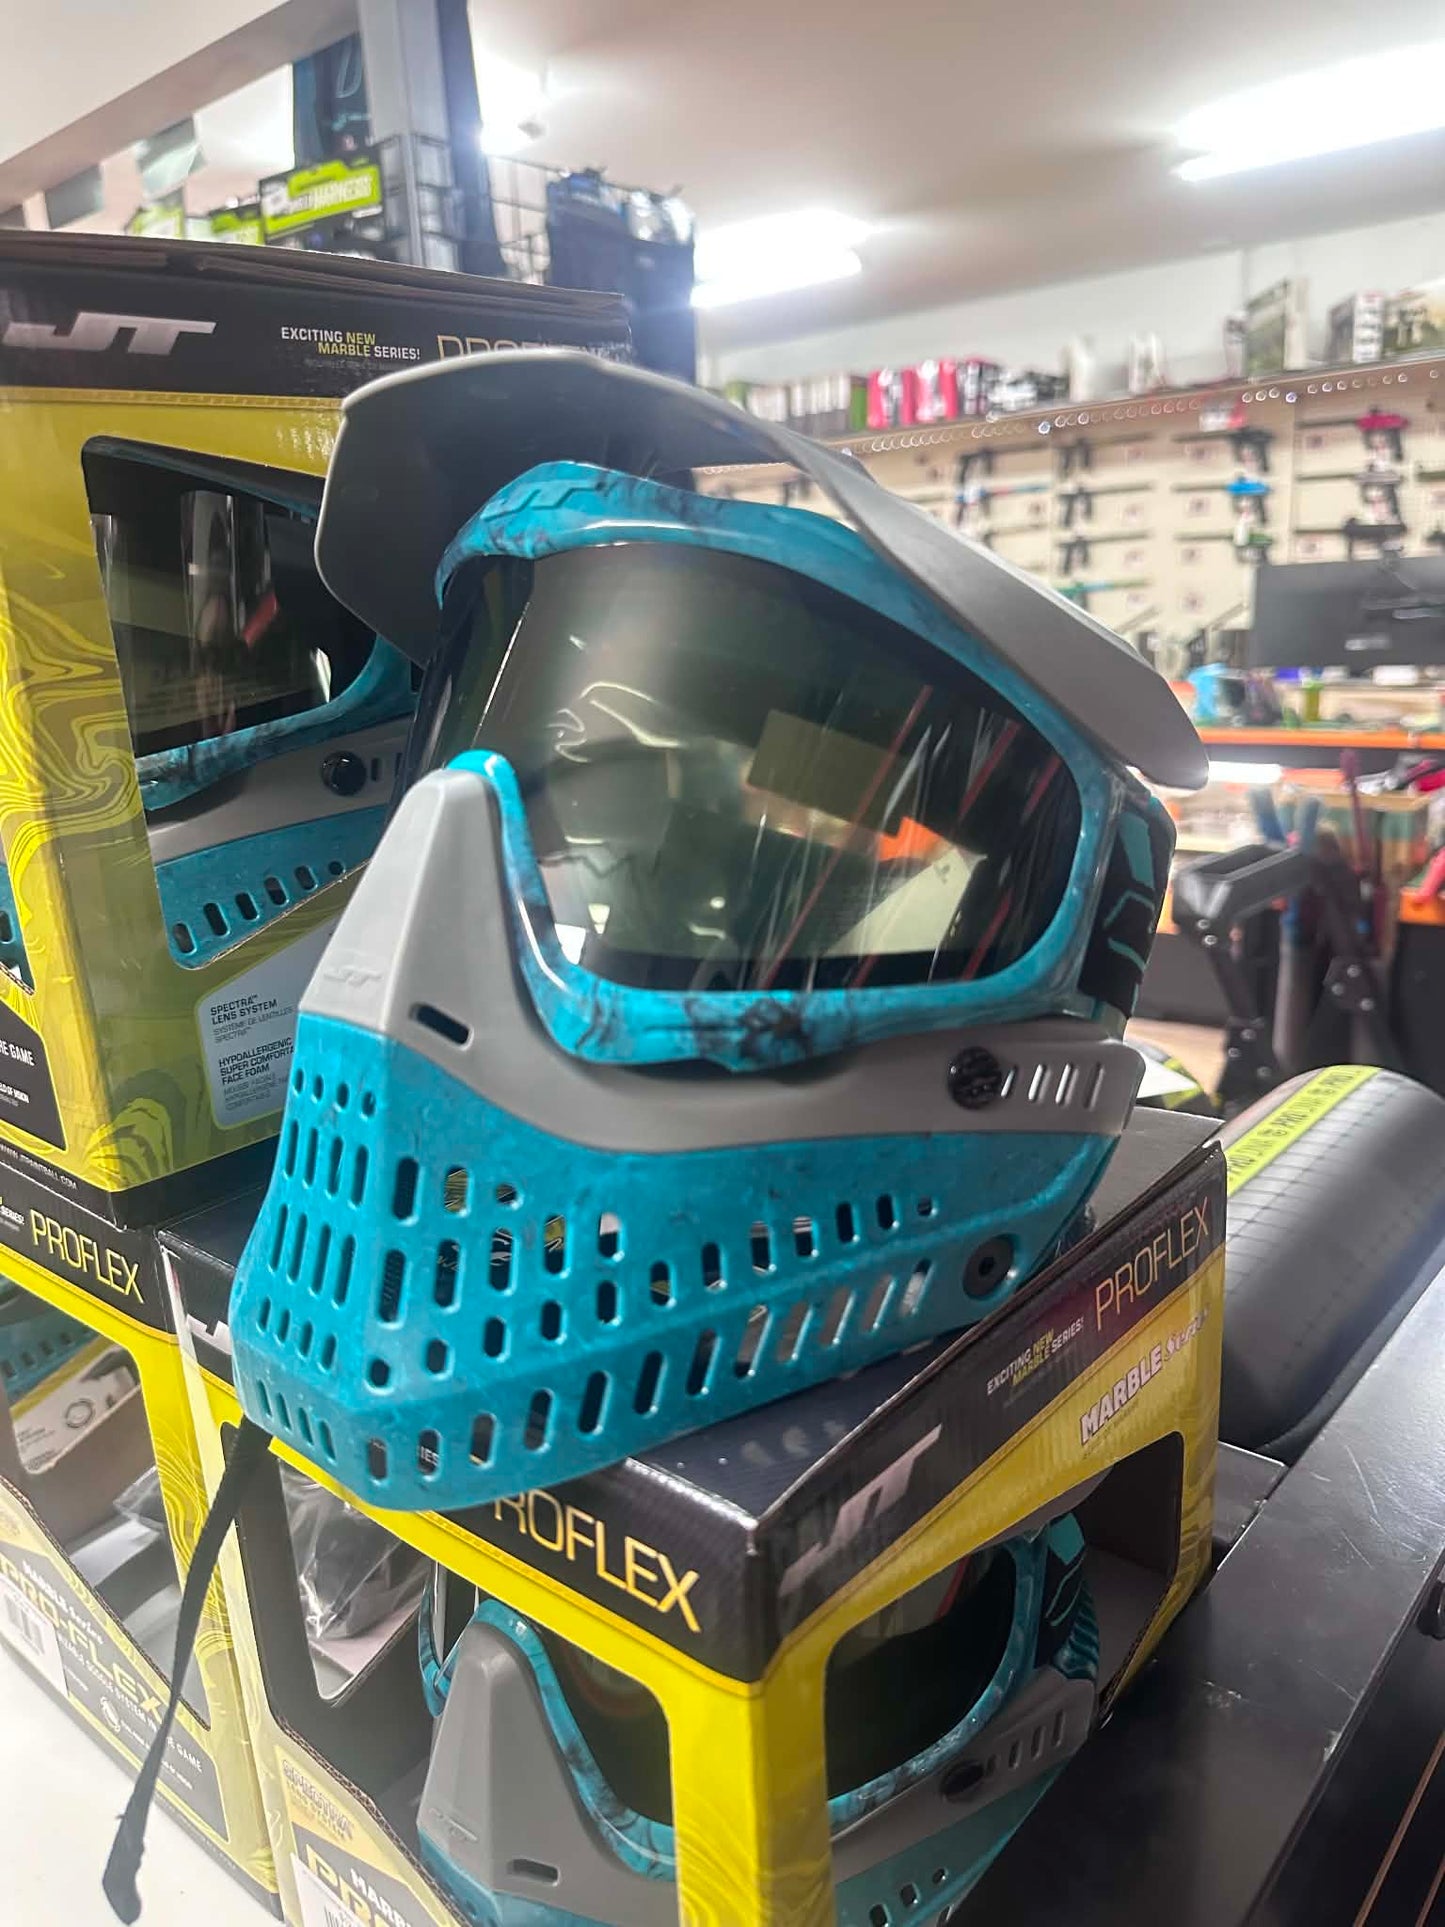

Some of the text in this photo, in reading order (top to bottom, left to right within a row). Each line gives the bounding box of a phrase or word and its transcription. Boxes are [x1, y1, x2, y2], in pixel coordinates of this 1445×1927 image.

[2, 312, 217, 356] JT
[281, 327, 376, 346] EXCITING NEW
[318, 341, 370, 358] MARBLE
[374, 346, 421, 360] SERIES!
[212, 999, 277, 1025] LENS SYSTEM
[9, 1044, 35, 1066] GAME
[219, 1036, 292, 1067] HYPOALLERGENIC
[221, 1046, 294, 1076] SUPER COMFORTA
[222, 1072, 244, 1086] FACE
[245, 1062, 270, 1077] FOAM
[30, 1208, 144, 1304] PROFLEX
[1095, 1195, 1209, 1331] PROFLEX
[986, 1348, 1031, 1396] EXCITING
[1032, 1328, 1055, 1359] NEW
[1012, 1347, 1050, 1386] MARBLE
[1051, 1316, 1085, 1353] SERIES!
[1080, 1344, 1163, 1446] MARBLE
[494, 1488, 701, 1634] ROFLEX
[350, 1868, 411, 1927] MARB
